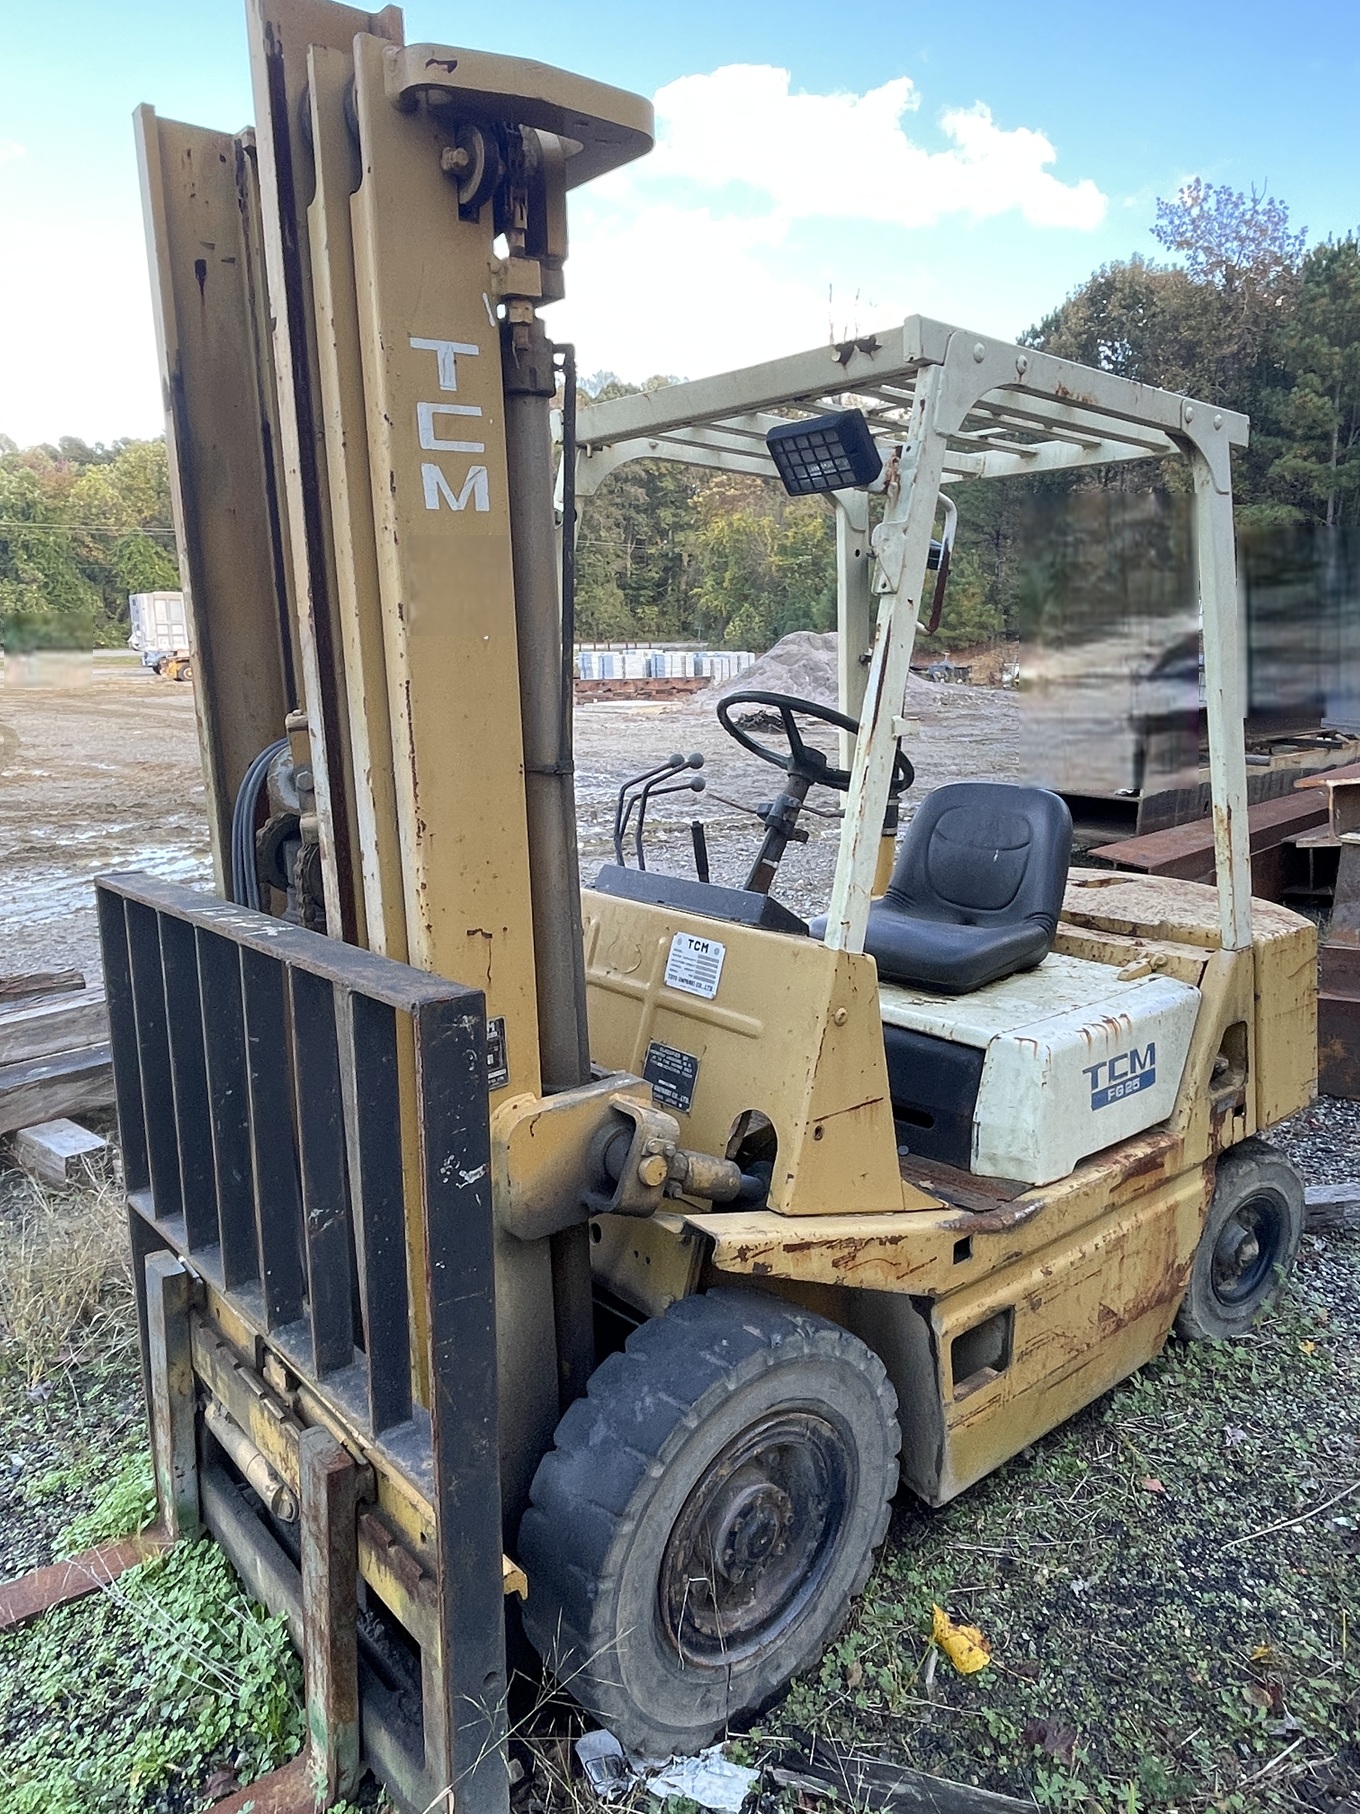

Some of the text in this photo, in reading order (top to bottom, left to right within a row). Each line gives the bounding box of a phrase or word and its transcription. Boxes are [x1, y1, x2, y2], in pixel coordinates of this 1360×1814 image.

[410, 337, 490, 512] TCM
[688, 939, 709, 953] TCM
[1082, 1042, 1156, 1092] TCM
[1107, 1077, 1140, 1101] FG25
